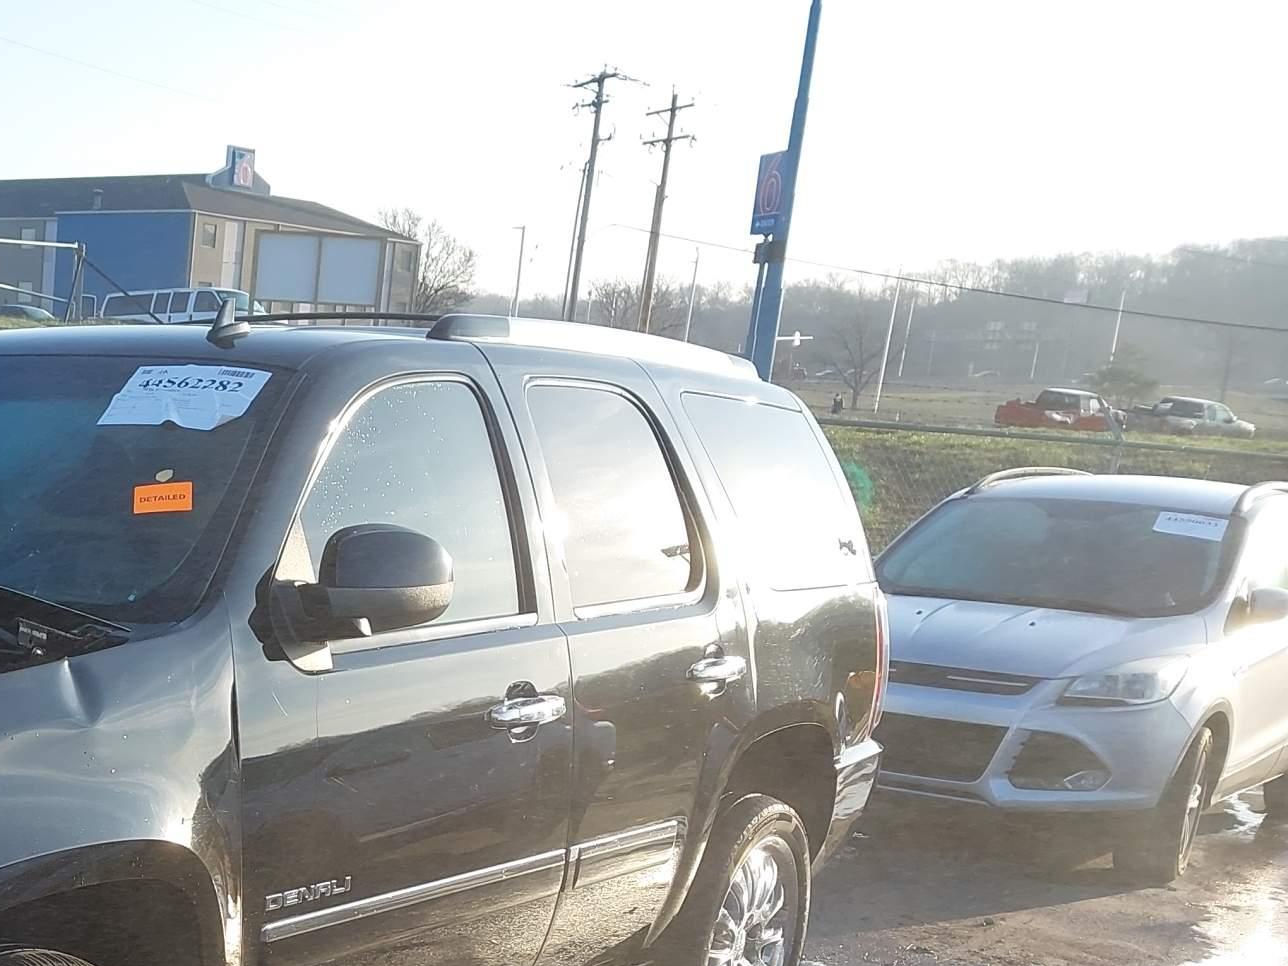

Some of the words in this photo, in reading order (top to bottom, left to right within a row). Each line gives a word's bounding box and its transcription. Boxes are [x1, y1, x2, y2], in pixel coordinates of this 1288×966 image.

[760, 153, 782, 216] 6
[138, 376, 243, 392] 44562282
[139, 493, 186, 503] DETAILED
[265, 875, 352, 911] DENALI
